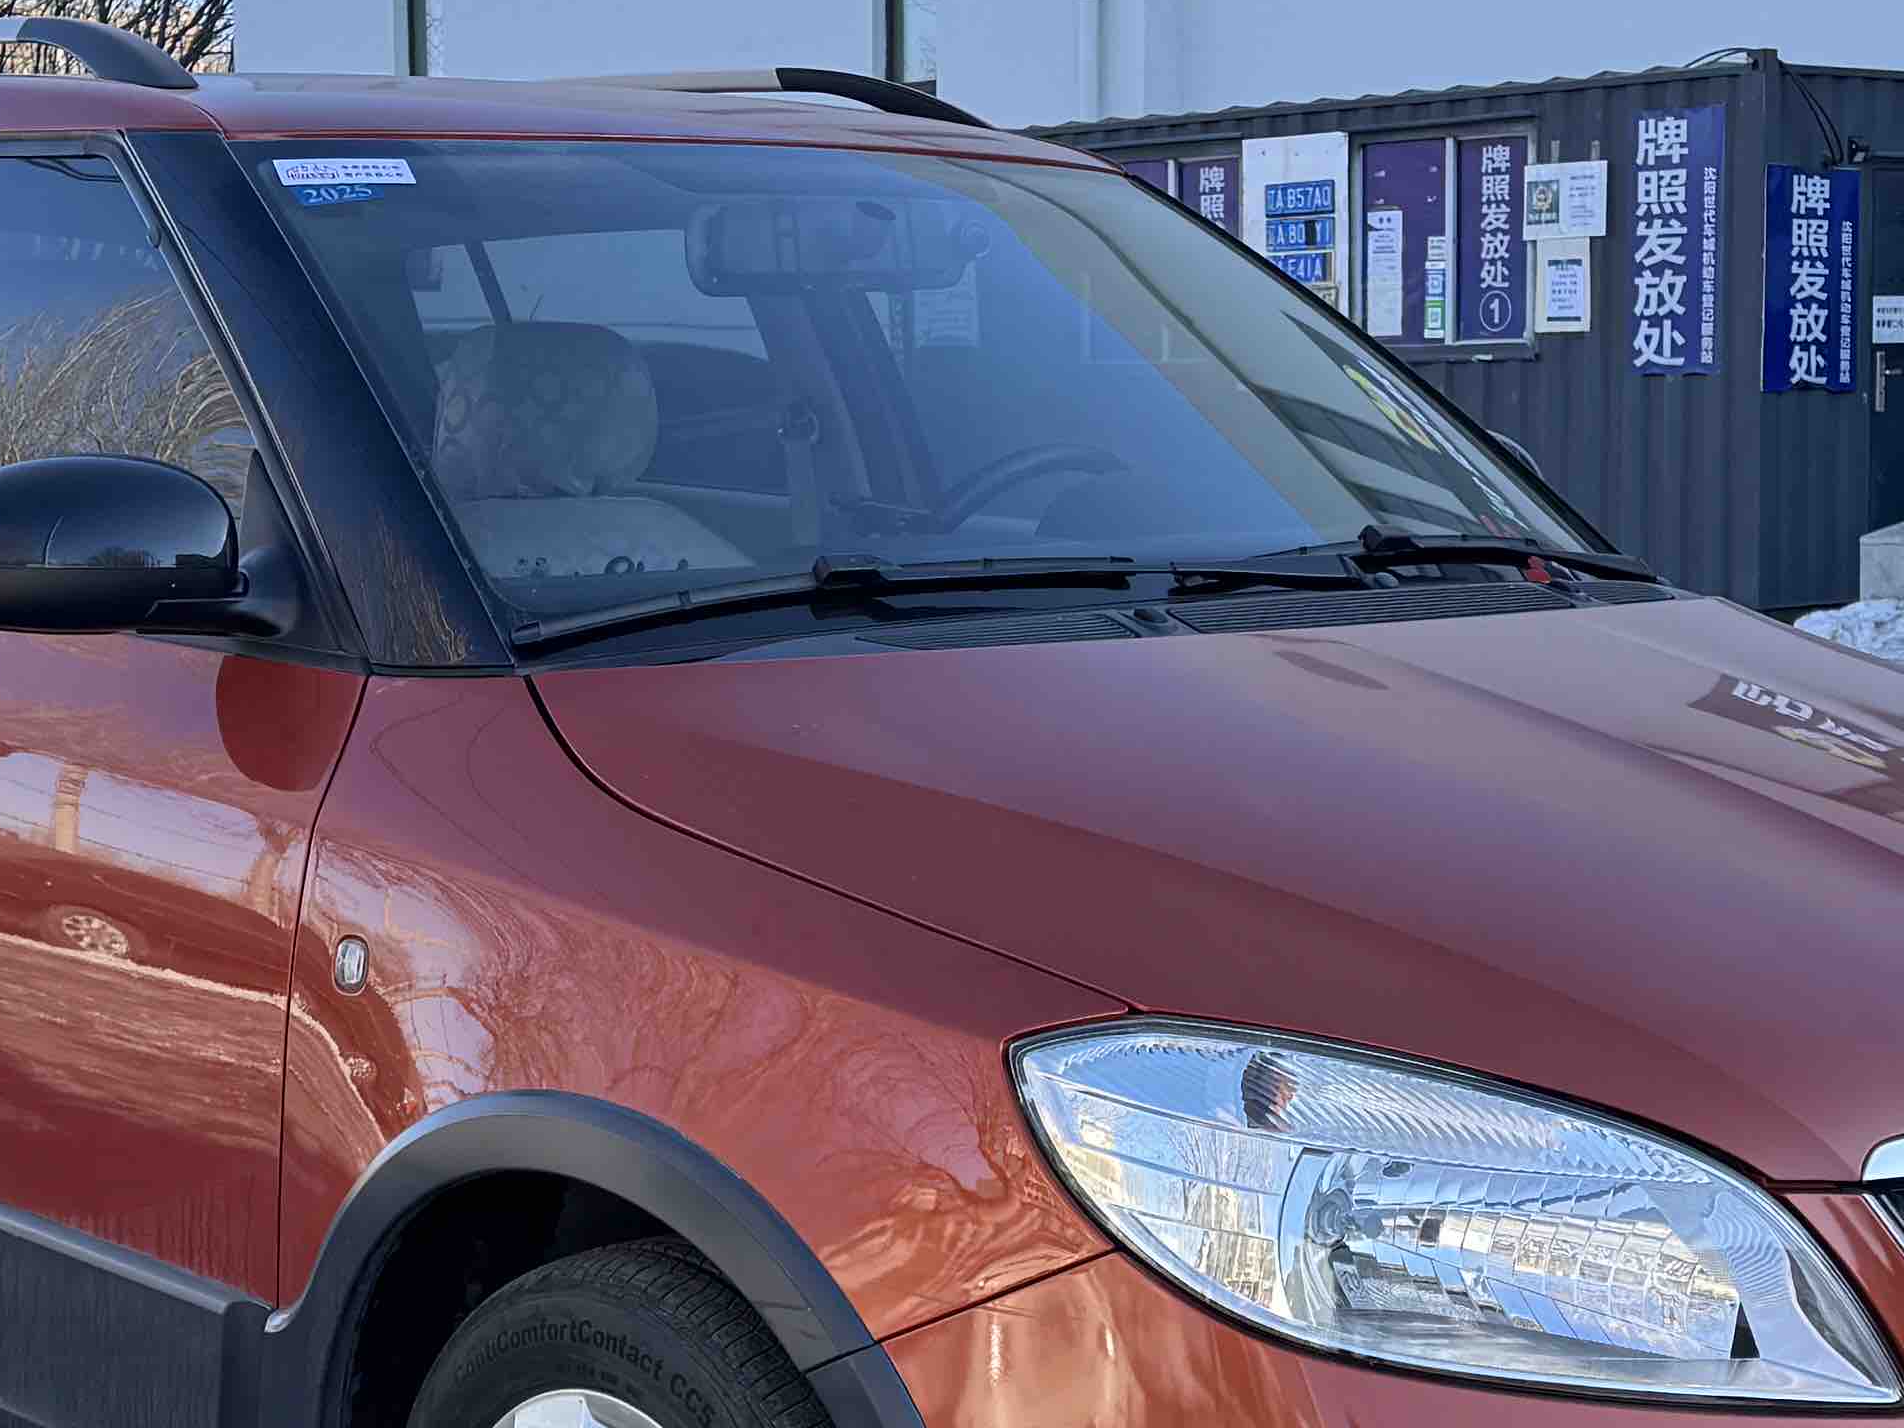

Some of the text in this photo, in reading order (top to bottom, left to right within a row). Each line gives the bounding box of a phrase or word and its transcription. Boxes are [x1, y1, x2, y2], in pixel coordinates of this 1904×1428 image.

[303, 185, 373, 204] 2025
[1199, 166, 1225, 228] 牌照
[1632, 116, 1688, 369] 牌照发放处
[1789, 174, 1831, 385] 牌照发放处
